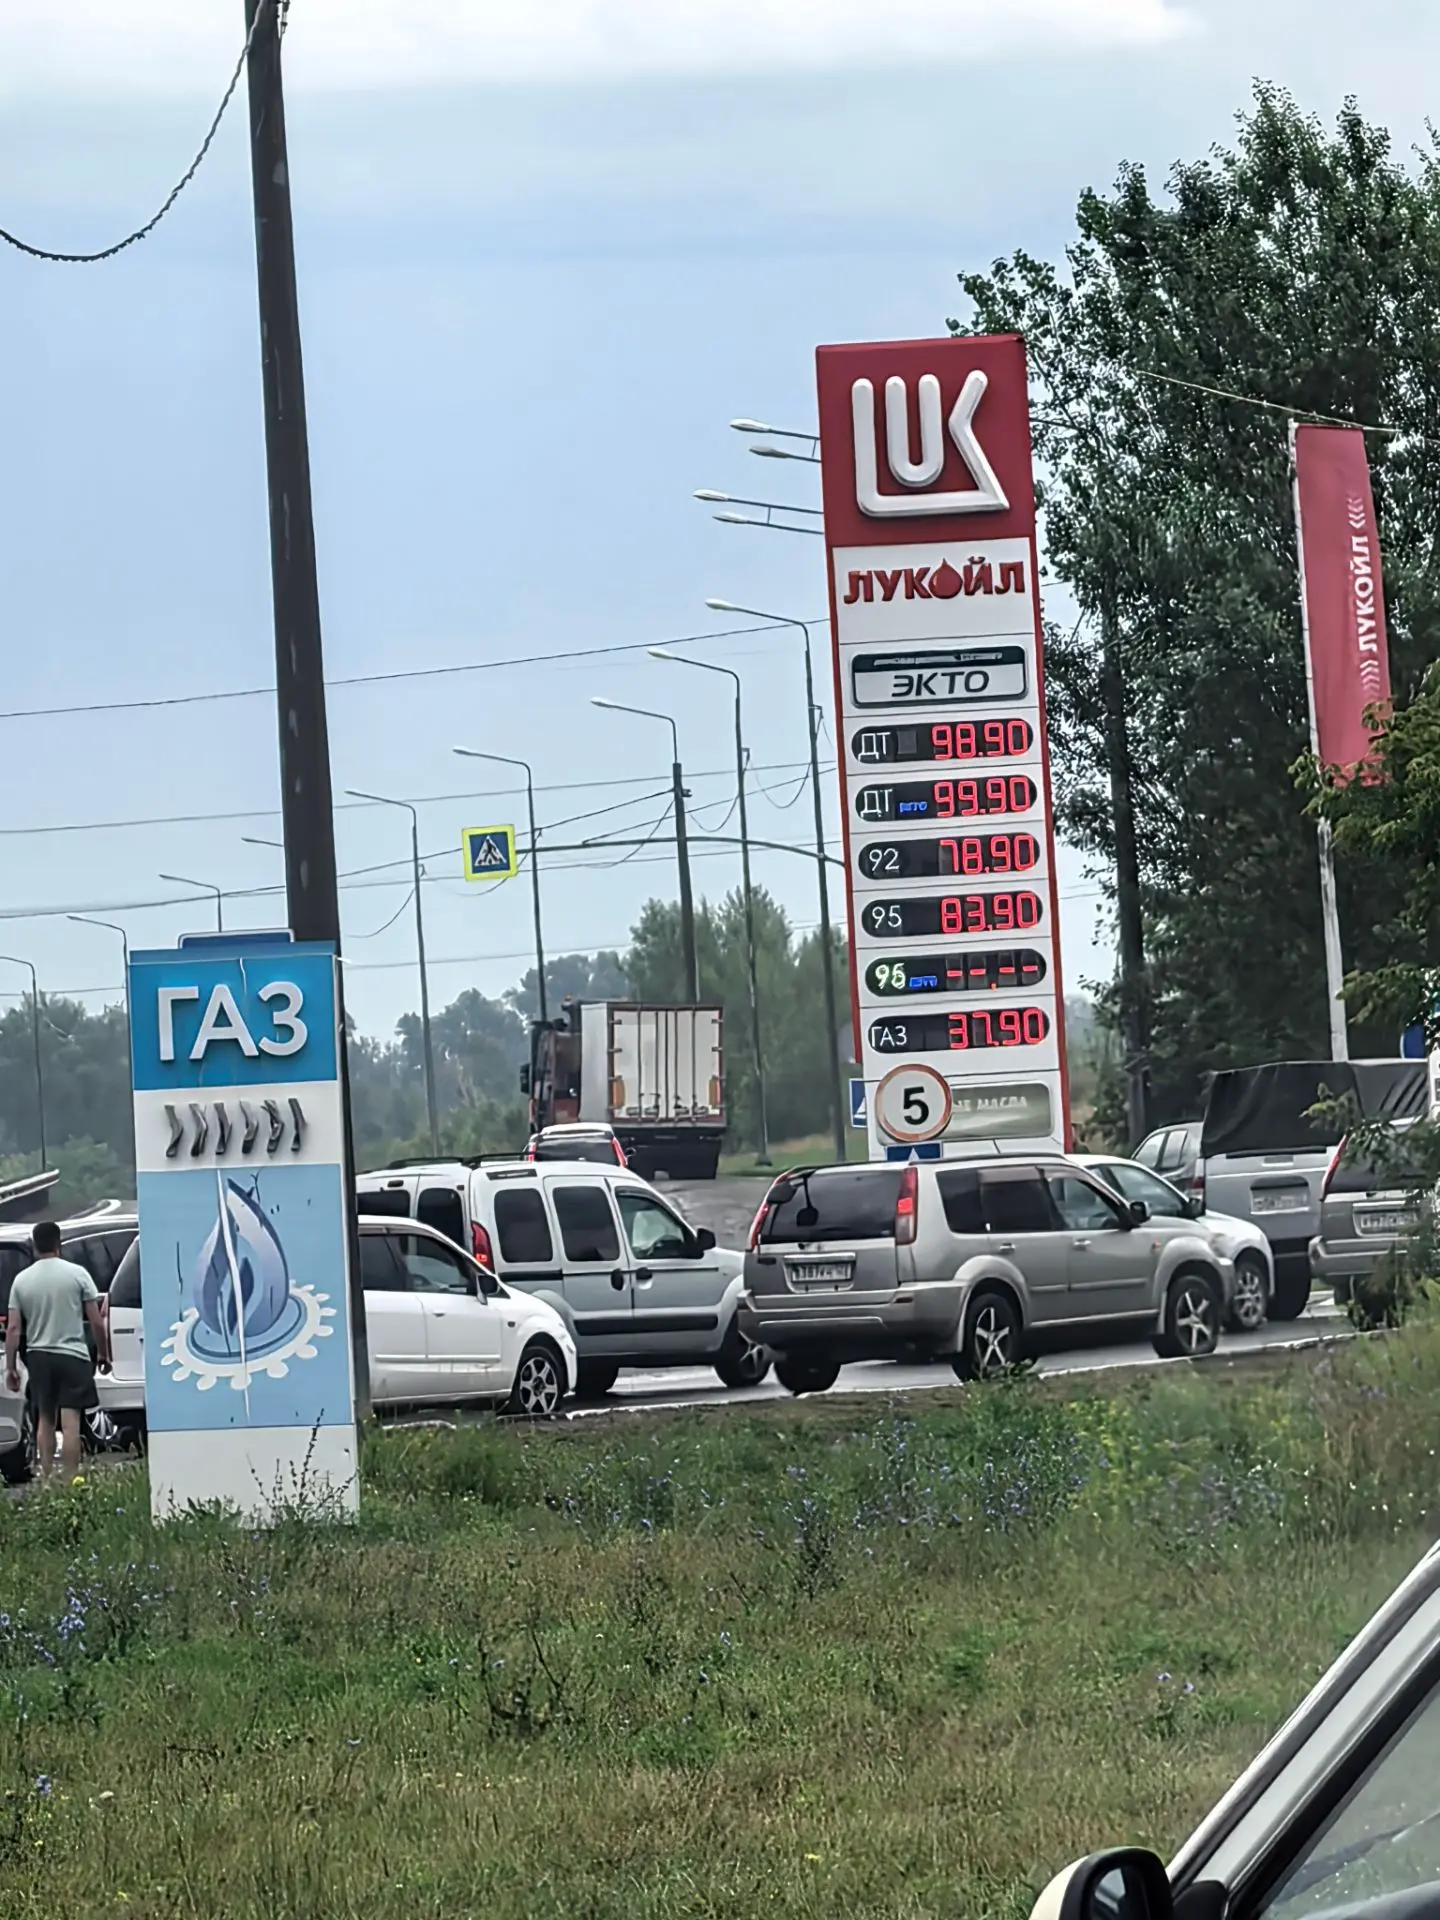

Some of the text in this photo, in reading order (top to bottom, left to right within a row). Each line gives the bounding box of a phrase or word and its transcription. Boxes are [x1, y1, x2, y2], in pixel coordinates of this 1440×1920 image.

[843, 557, 1025, 605] ЛУКОЙЛ
[1350, 535, 1379, 653] ЛУКОЙЛ
[891, 670, 990, 698] ЭКТО
[858, 720, 1028, 762] ДТ 98.90
[860, 788, 893, 818] ДТ
[934, 776, 1030, 818] 99.90
[869, 848, 900, 872] 92
[872, 905, 902, 929] 95
[157, 980, 308, 1062] ГАЗ
[871, 1006, 1045, 1049] ГАЗ 37.90
[903, 1086, 930, 1126] 5
